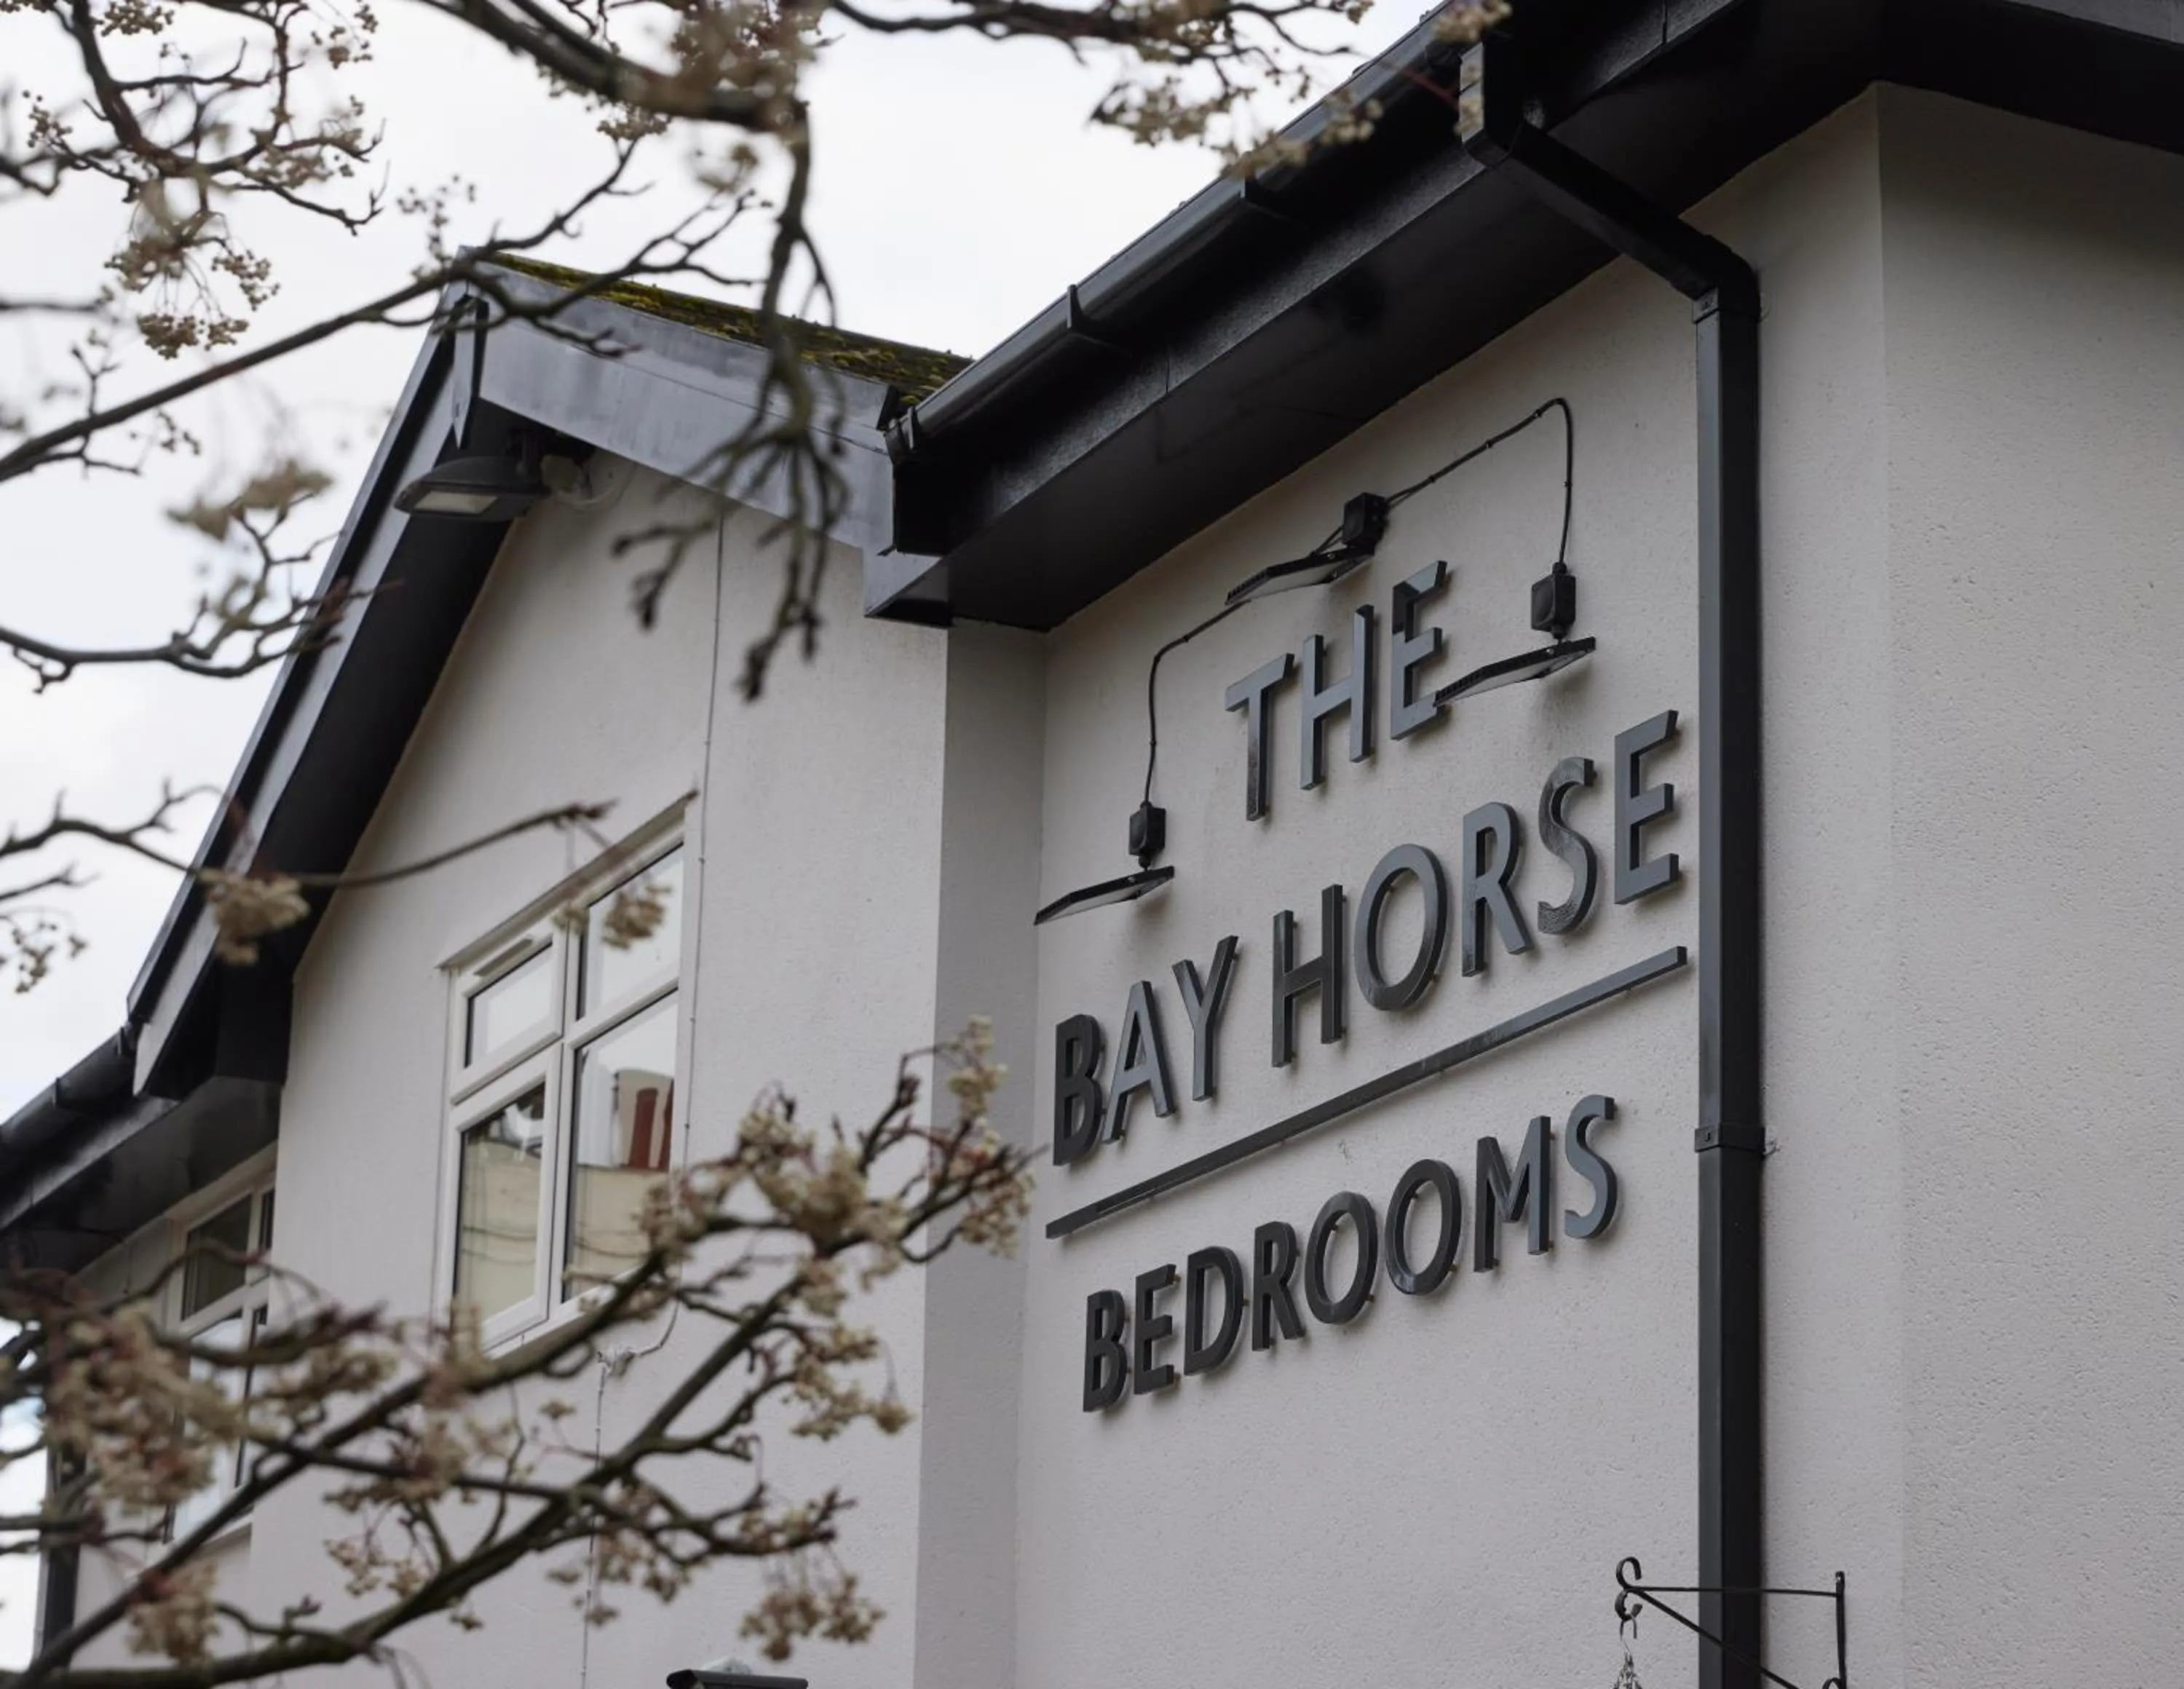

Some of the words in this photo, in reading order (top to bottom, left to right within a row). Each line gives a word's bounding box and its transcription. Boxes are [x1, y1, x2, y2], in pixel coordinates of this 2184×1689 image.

[1224, 561, 1447, 822] THE
[1052, 935, 1239, 1166] BAY
[1272, 710, 1679, 1068] HORSE
[1083, 1094, 1618, 1412] BEDROOMS
